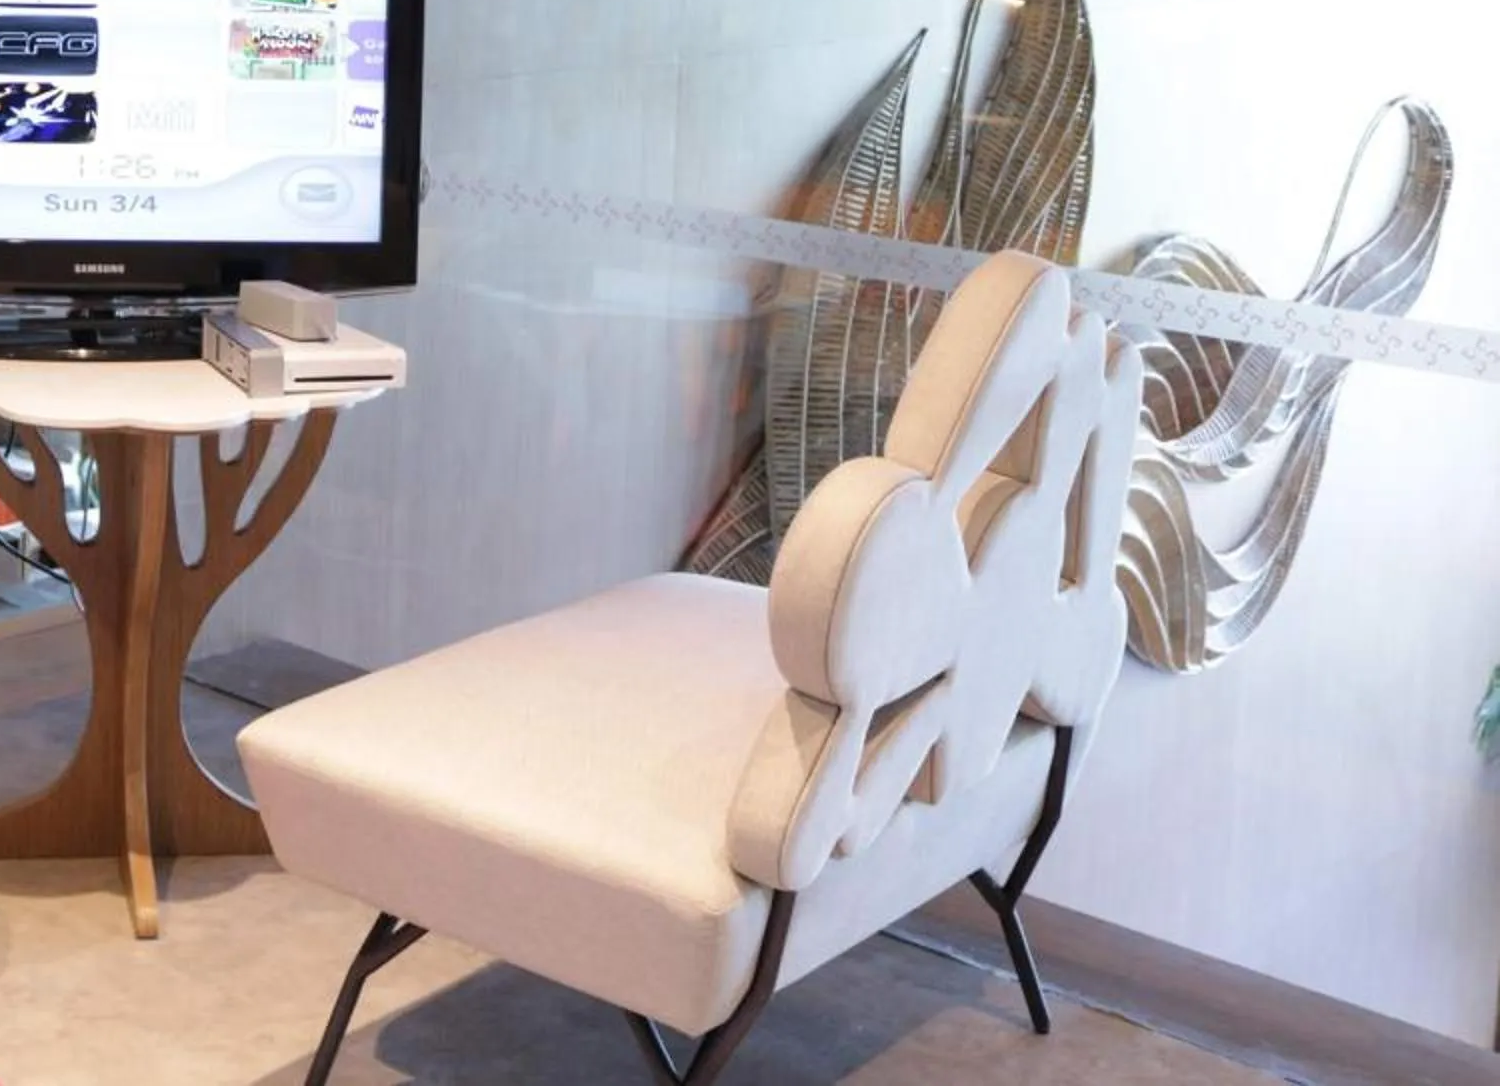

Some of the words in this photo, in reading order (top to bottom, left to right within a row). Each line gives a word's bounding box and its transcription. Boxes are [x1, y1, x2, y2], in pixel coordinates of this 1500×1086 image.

[79, 154, 157, 179] 1:26
[44, 193, 98, 213] Sun
[109, 194, 158, 213] 3/4
[74, 263, 125, 274] SAMSUNG
